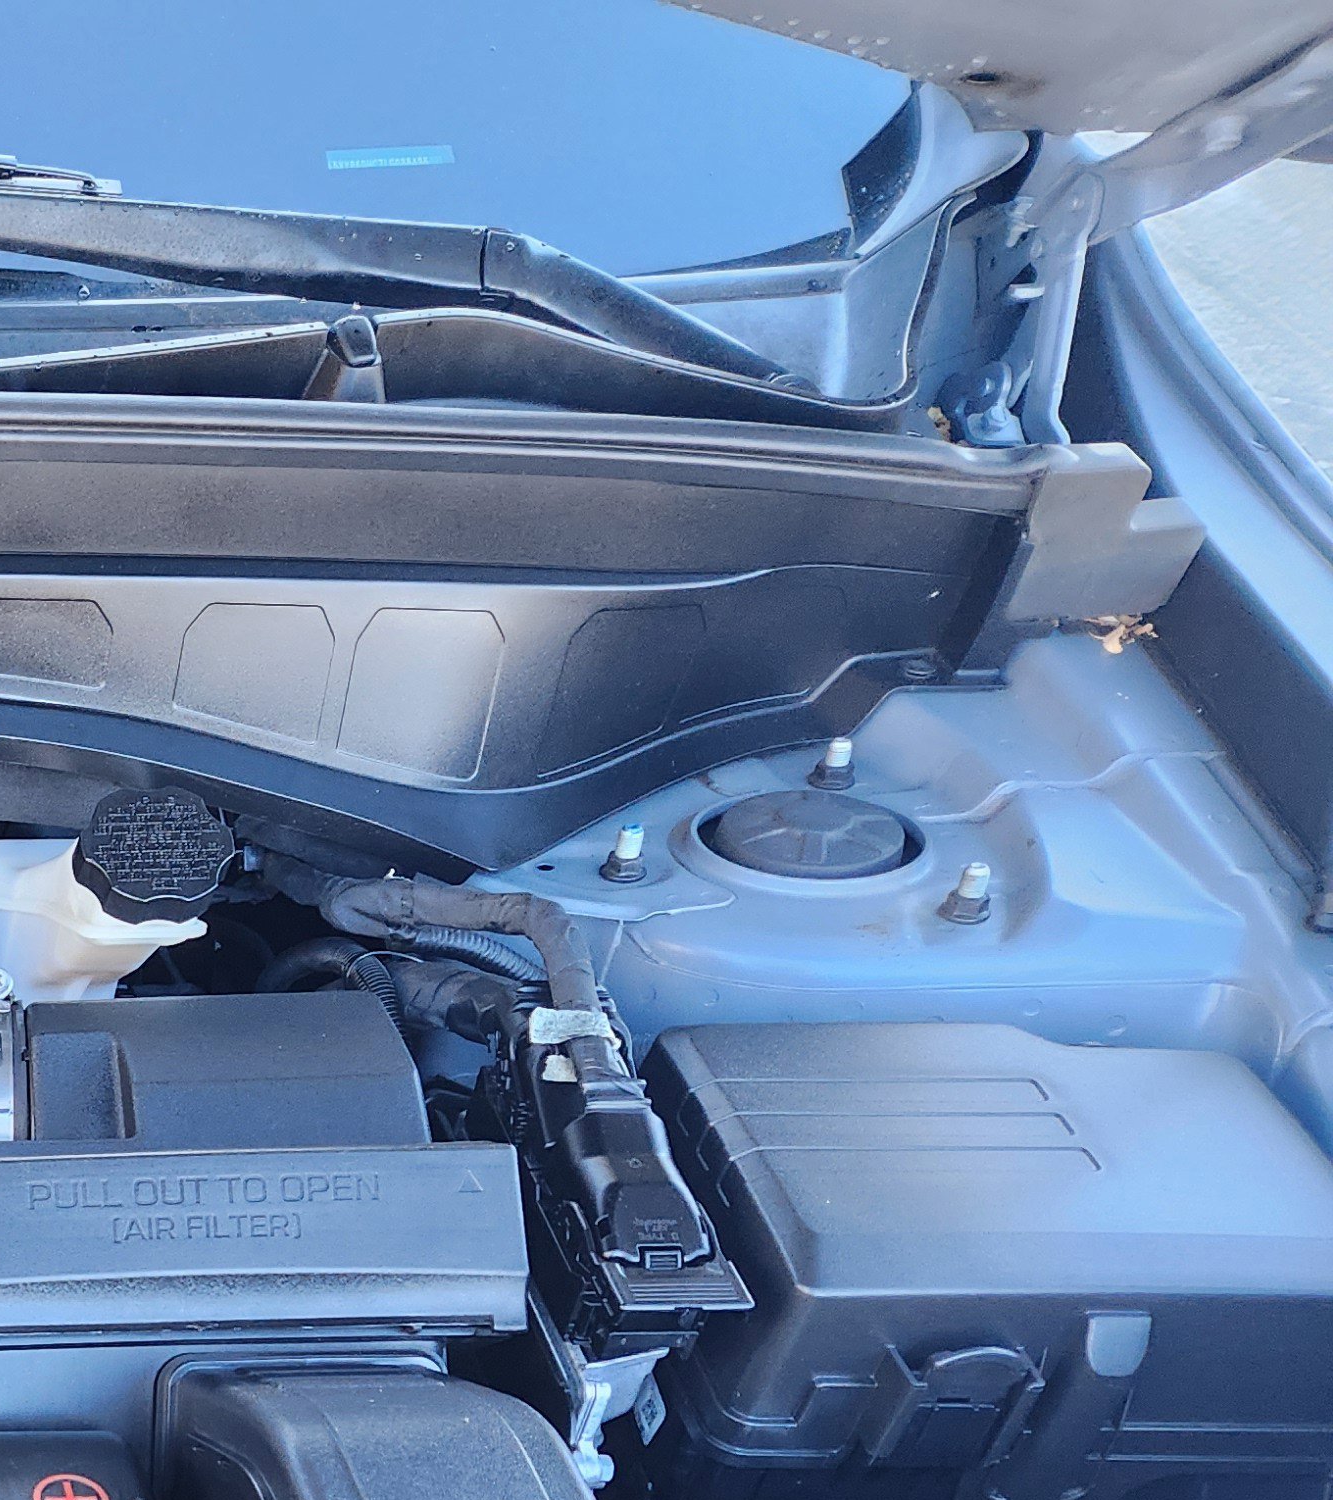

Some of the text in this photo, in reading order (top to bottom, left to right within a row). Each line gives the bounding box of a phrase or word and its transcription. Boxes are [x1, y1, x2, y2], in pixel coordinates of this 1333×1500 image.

[27, 1172, 380, 1210] PULL OUT TO OPEN
